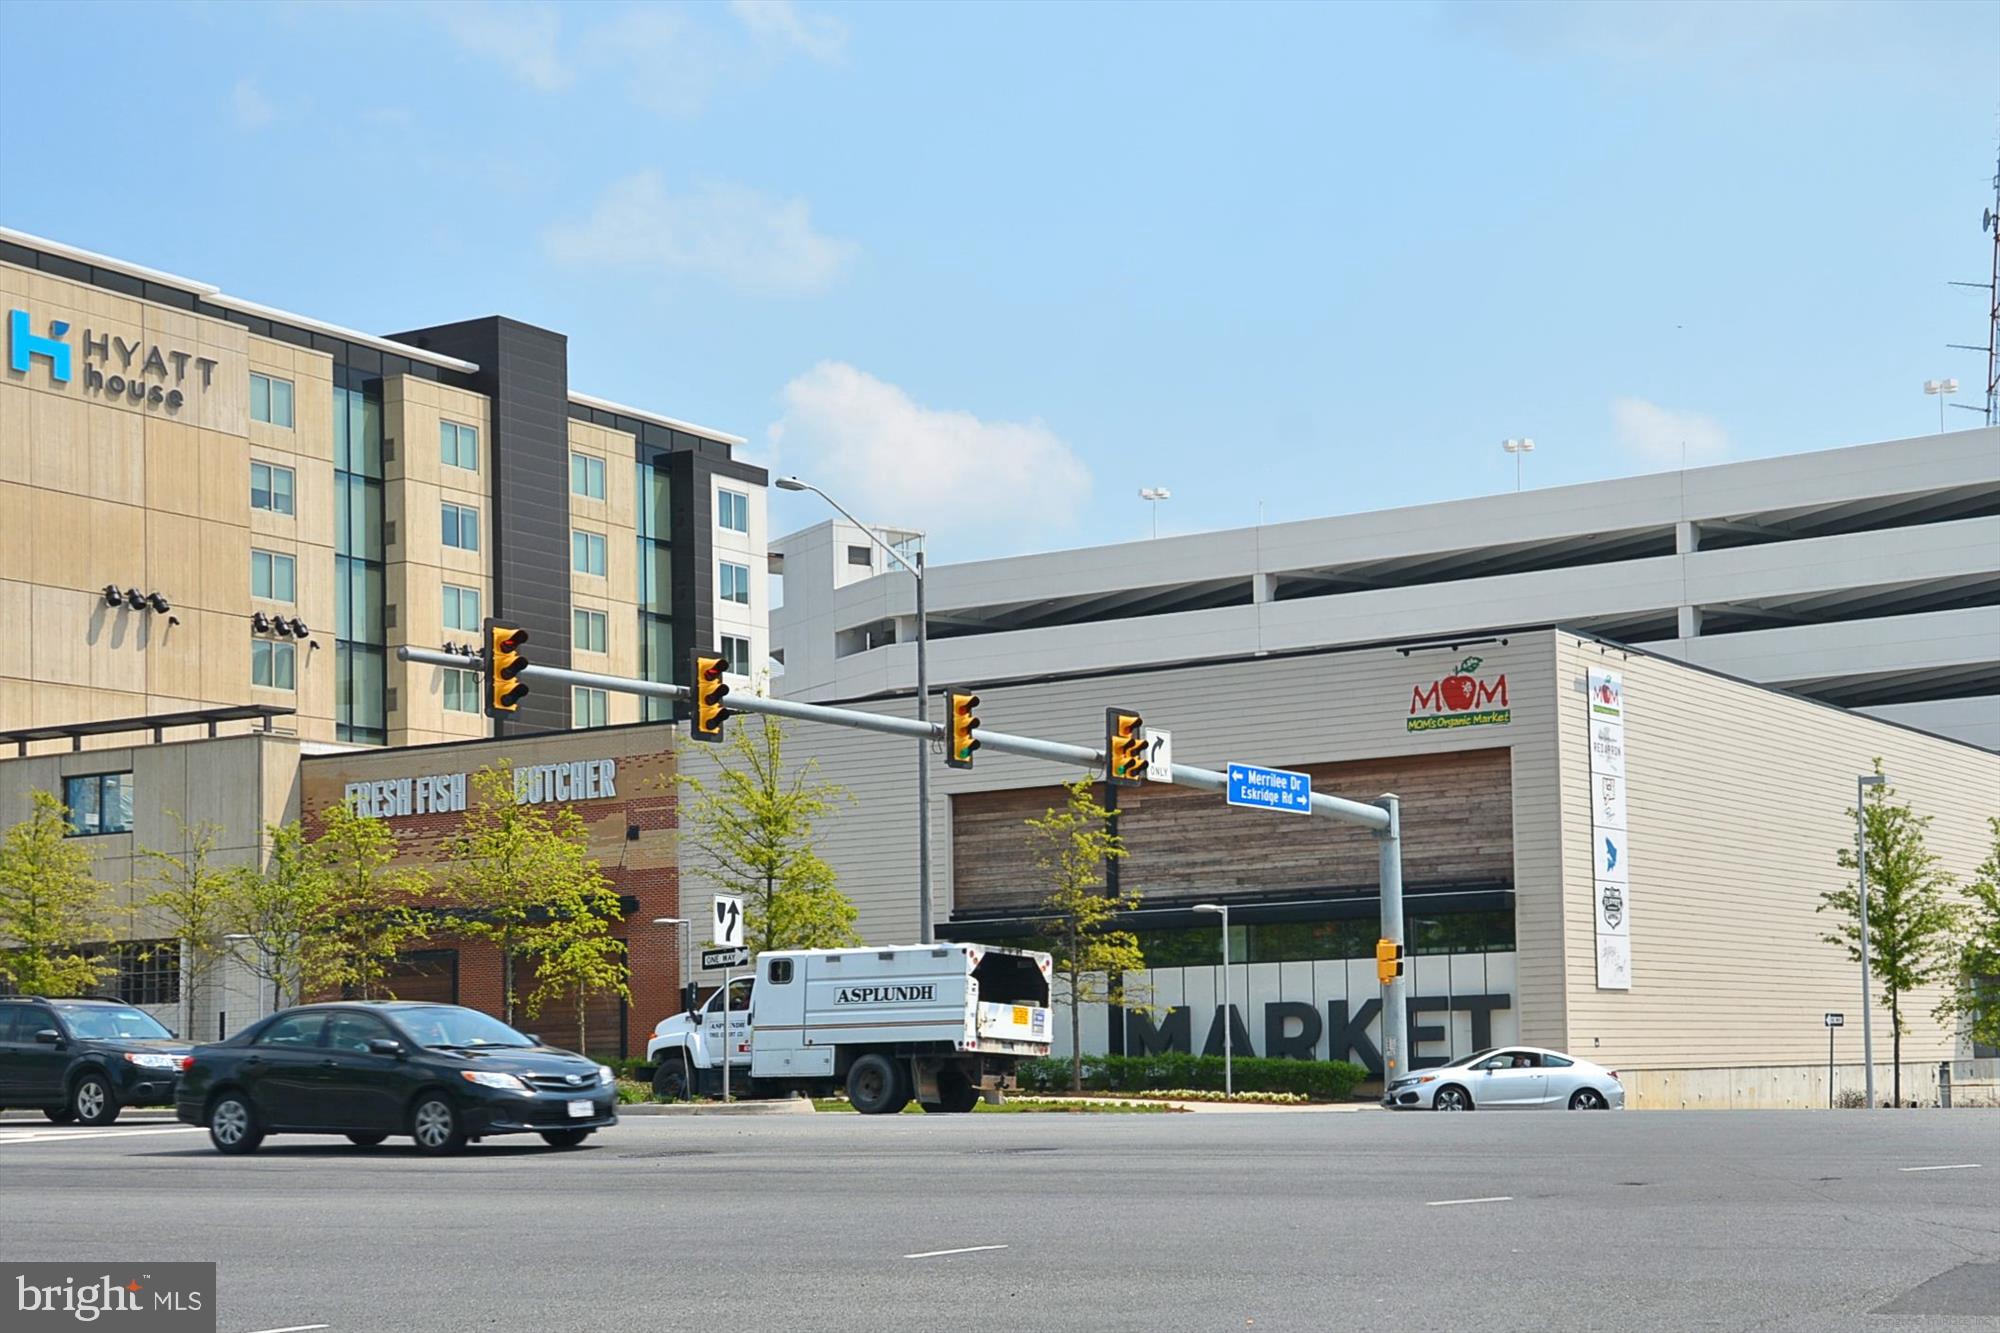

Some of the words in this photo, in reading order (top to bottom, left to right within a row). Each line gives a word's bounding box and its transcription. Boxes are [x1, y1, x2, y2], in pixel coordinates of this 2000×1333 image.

[83, 328, 218, 386] HYATT
[84, 362, 183, 407] house
[1438, 715, 1471, 728] Organic
[1151, 765, 1168, 777] ONLY
[1248, 770, 1287, 789] Merrilee
[1290, 777, 1302, 790] Dr
[345, 778, 412, 819] FRESH
[416, 773, 466, 814] FISH
[514, 758, 616, 805] BUTCHER
[1241, 786, 1279, 805] Eskridge
[1282, 790, 1293, 805] Rd
[706, 954, 719, 964] ONE
[722, 953, 736, 962] WAY
[837, 986, 933, 1002] ASPLUNDH
[1126, 993, 1511, 1074] MARKET
